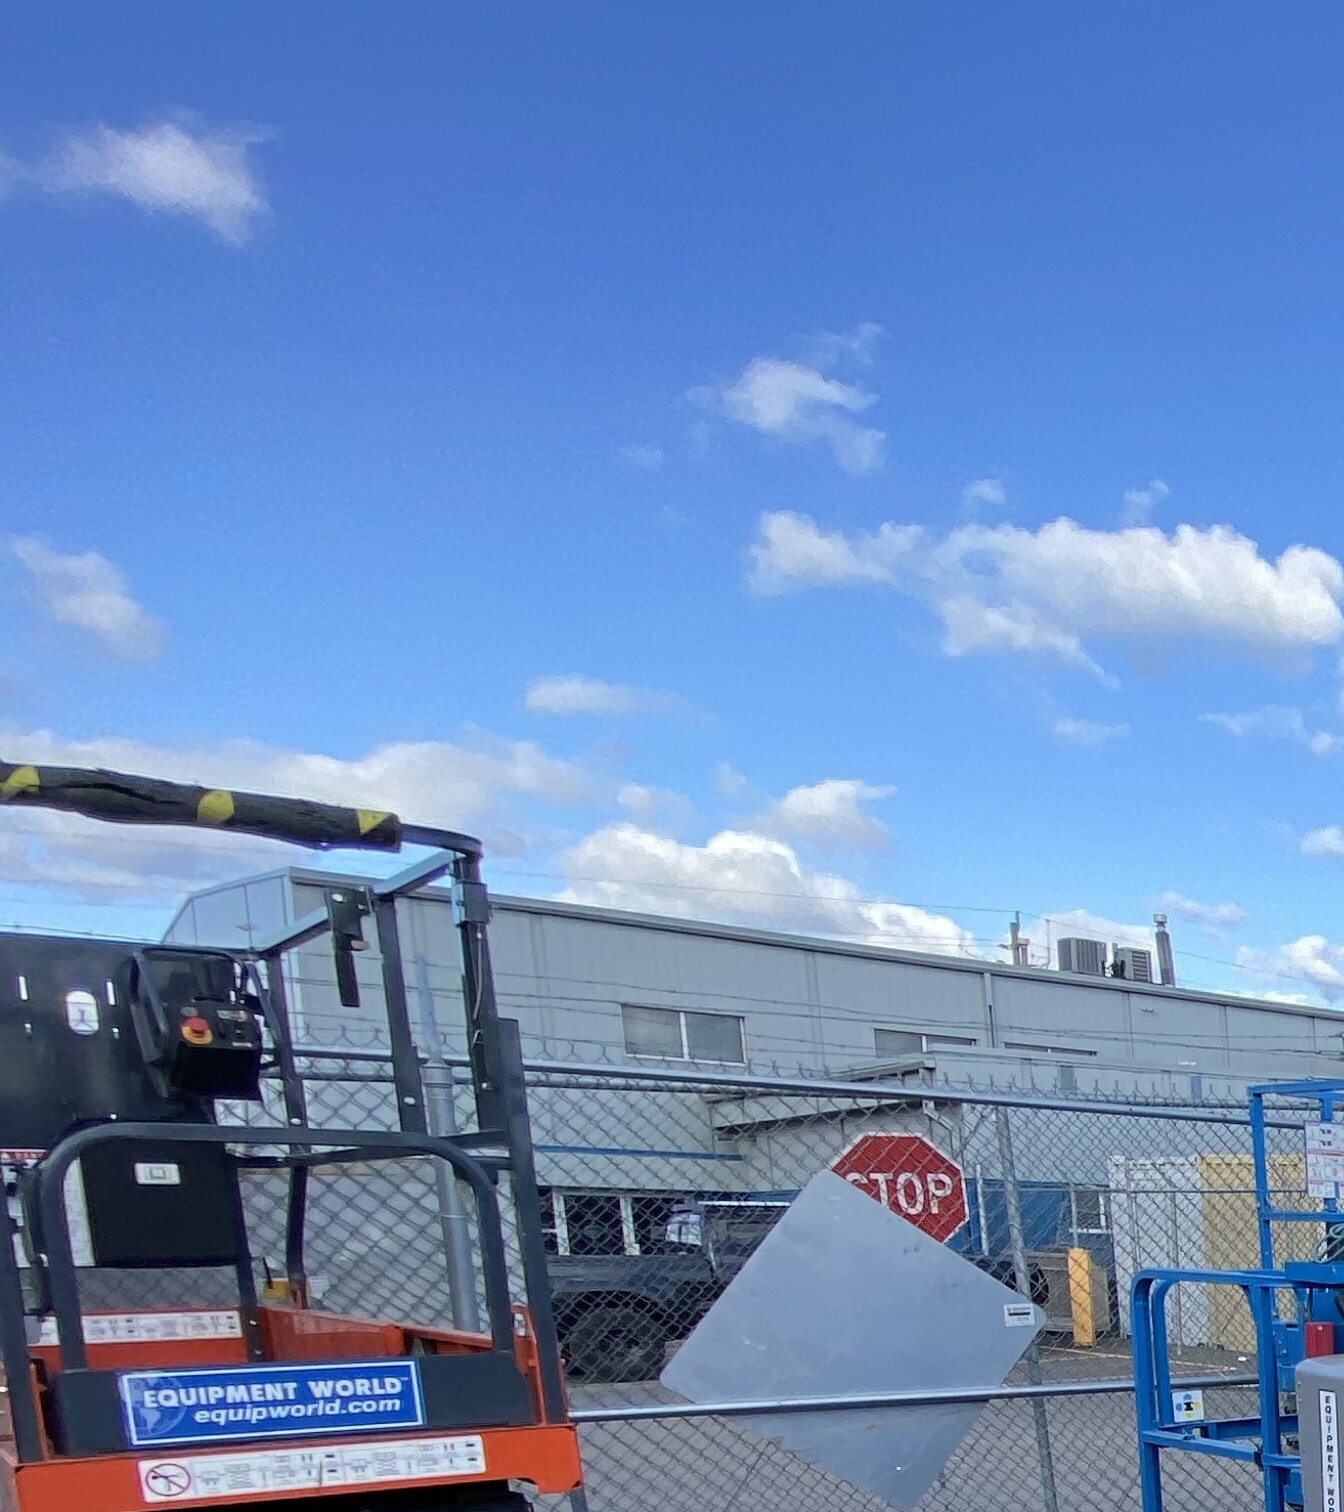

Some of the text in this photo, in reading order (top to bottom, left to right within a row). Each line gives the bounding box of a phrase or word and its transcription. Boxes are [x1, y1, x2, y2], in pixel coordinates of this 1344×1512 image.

[846, 1172, 953, 1215] TOP
[142, 1377, 402, 1409] EQUIPMENT WORLD
[194, 1397, 401, 1426] equipworld.com
[1324, 1395, 1336, 1482] EQUIPMENT
